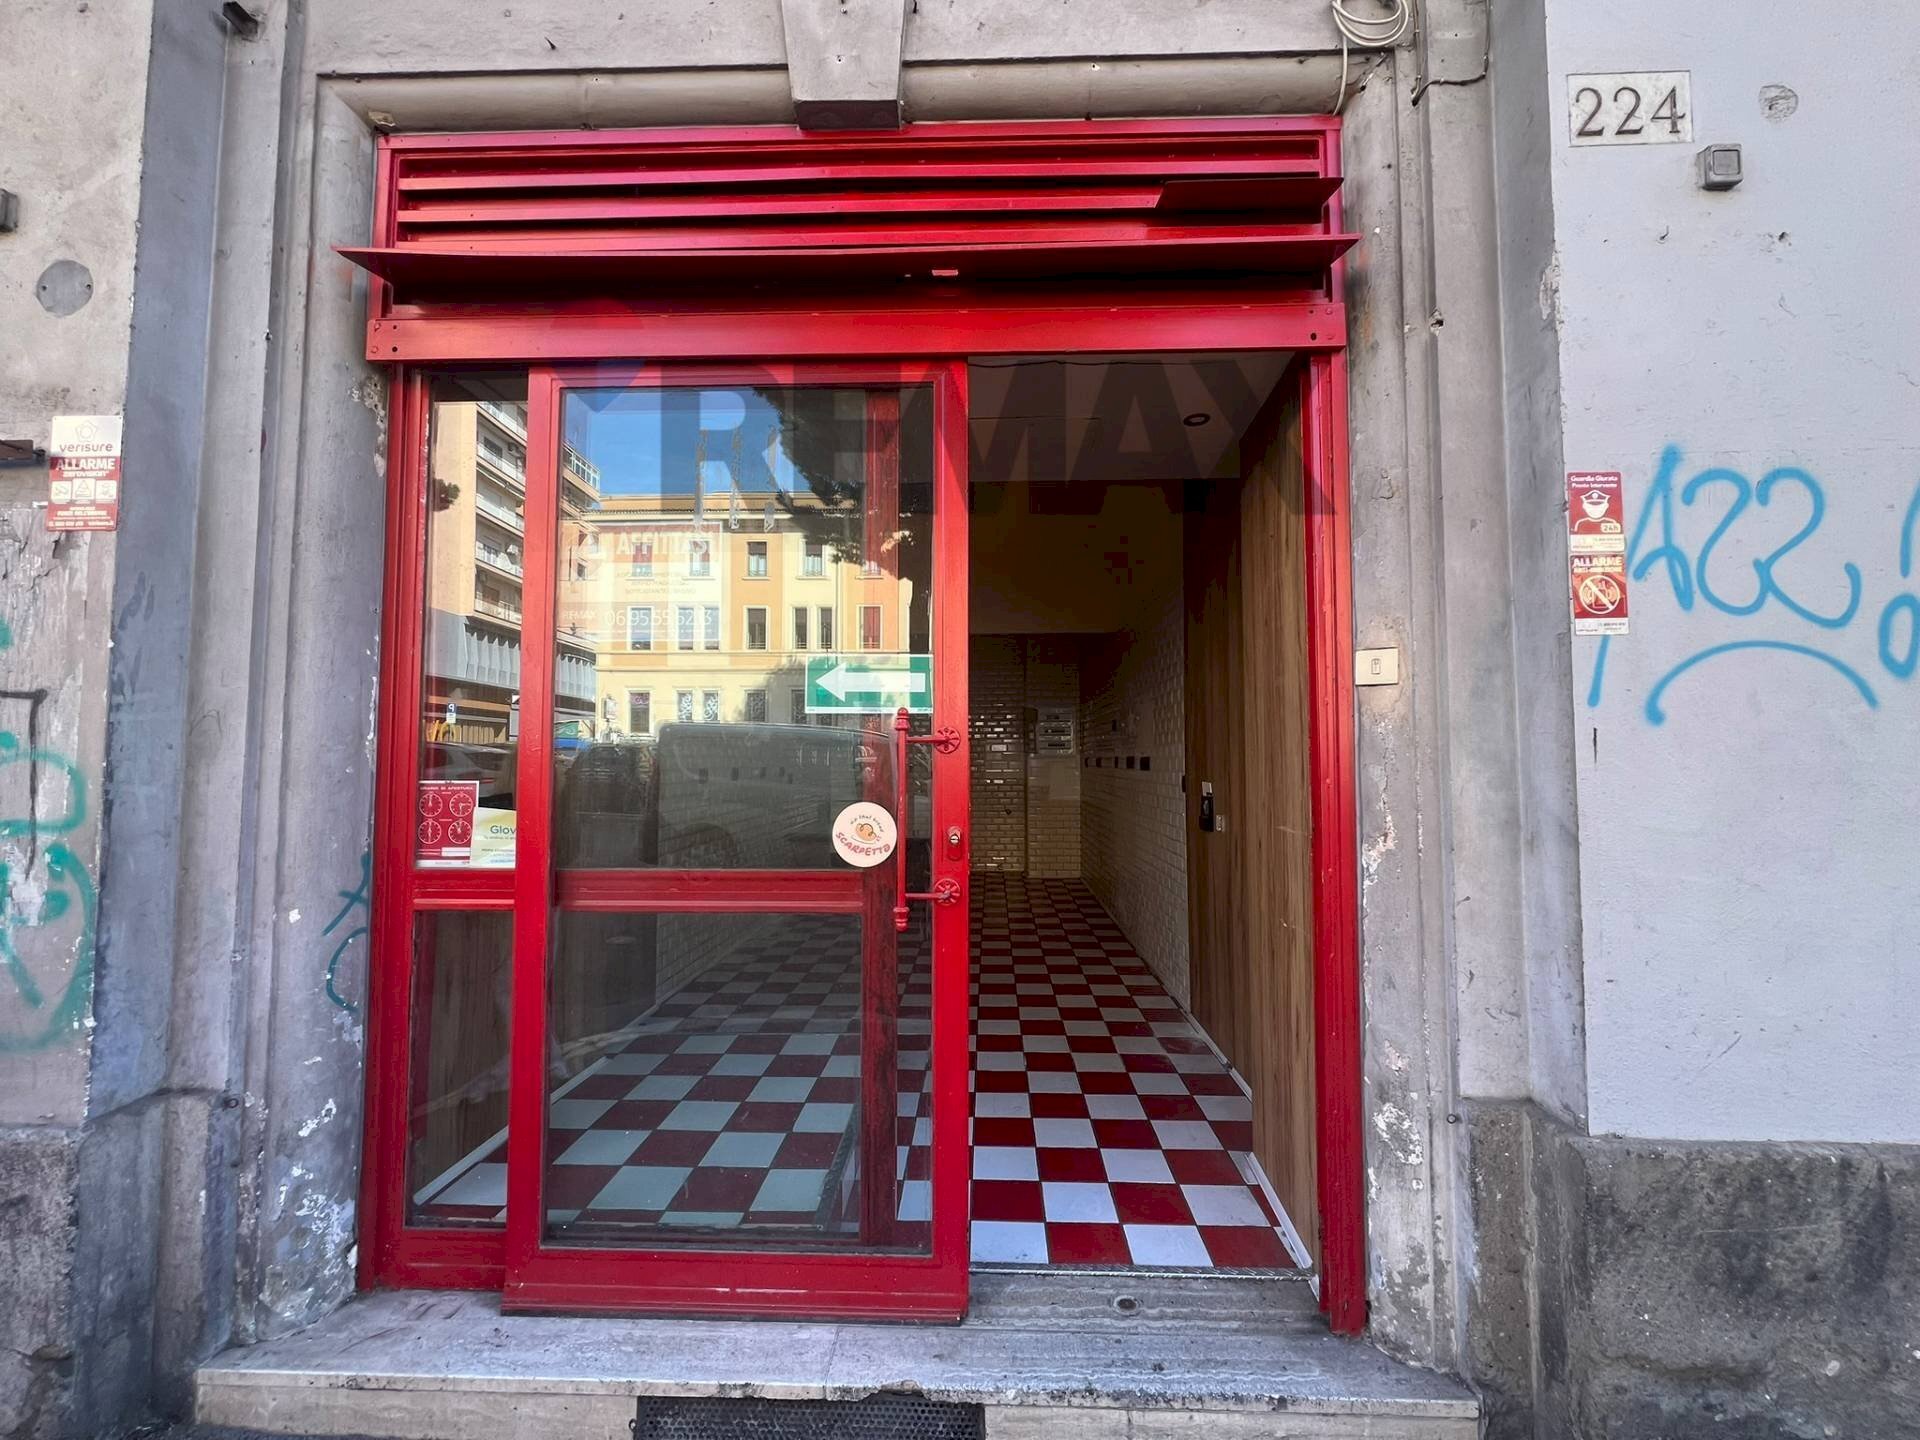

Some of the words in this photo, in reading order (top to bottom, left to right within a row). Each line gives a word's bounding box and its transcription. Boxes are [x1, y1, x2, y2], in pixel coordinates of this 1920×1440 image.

[1575, 85, 1686, 137] 224
[59, 442, 113, 453] verisure
[56, 458, 116, 470] ALLARME
[1603, 524, 1619, 532] 24h
[1573, 556, 1623, 566] ALLARME
